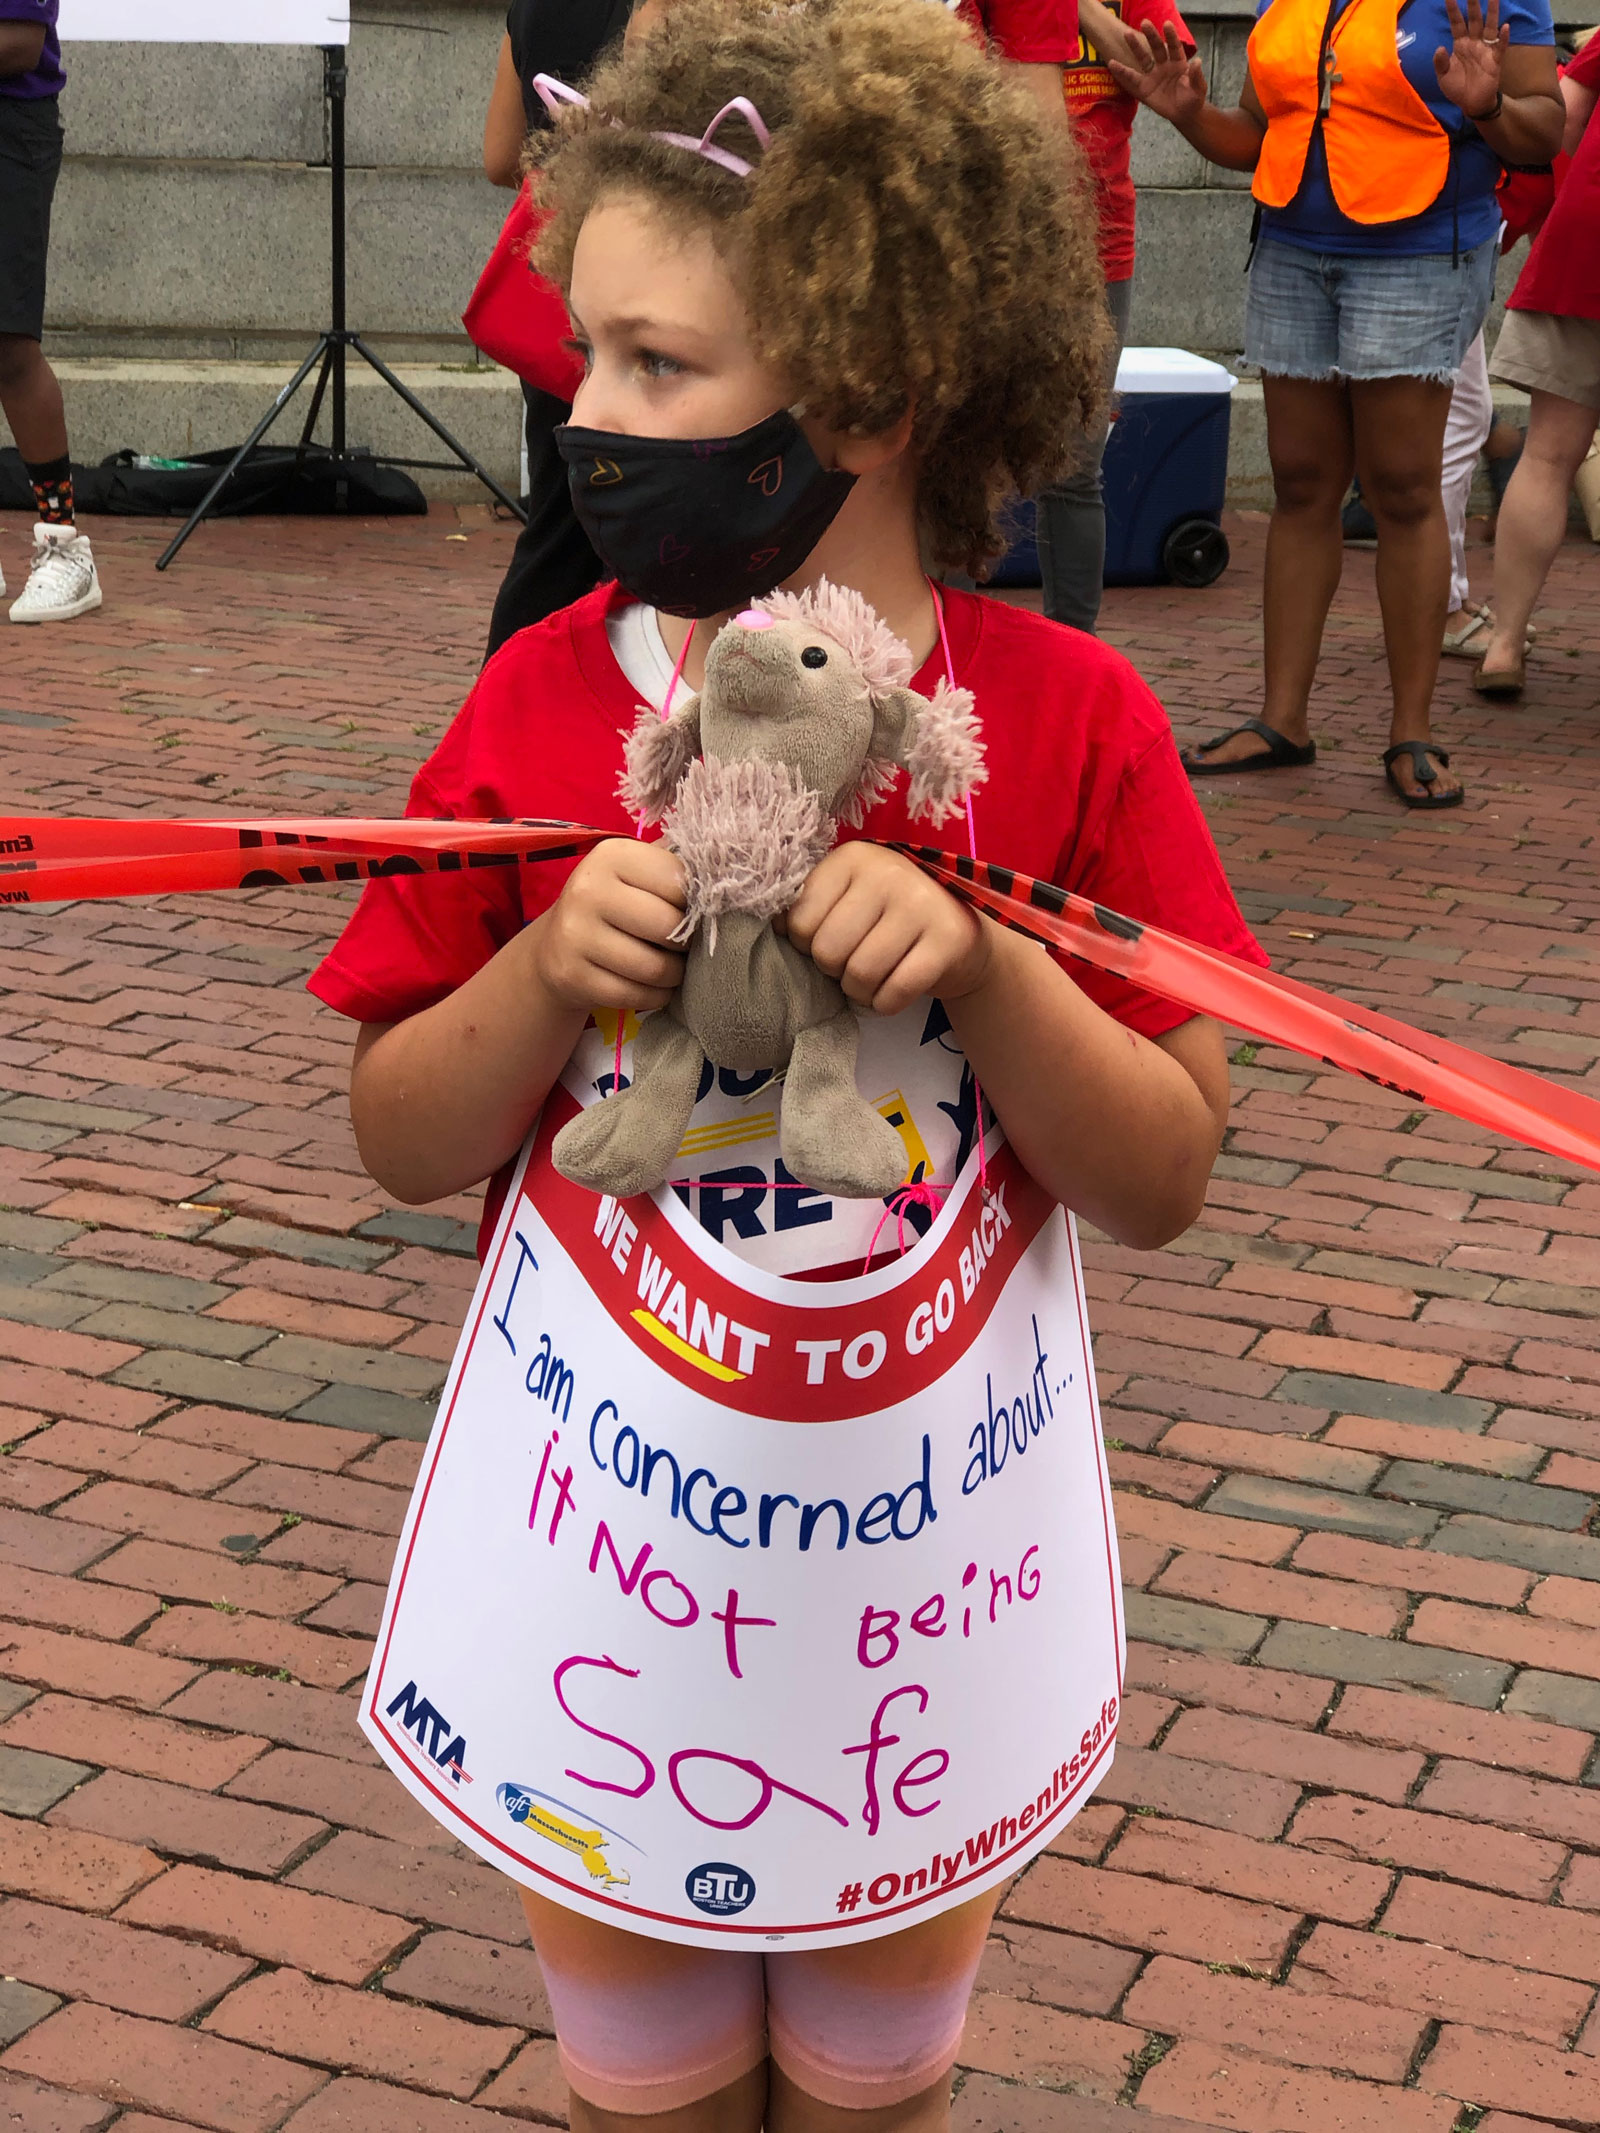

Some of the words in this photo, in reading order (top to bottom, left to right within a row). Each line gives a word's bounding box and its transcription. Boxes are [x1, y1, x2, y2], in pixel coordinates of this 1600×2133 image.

[494, 1231, 539, 1356] I
[526, 1333, 574, 1423] am
[593, 1194, 639, 1276] WE
[637, 1242, 771, 1376] WANT
[795, 1330, 888, 1385] TO
[905, 1278, 955, 1356] GO
[958, 1179, 1012, 1305] BACK
[386, 1680, 467, 1784] MTA
[836, 1697, 1117, 1913] #OnlyWhenItsSafe
[693, 1871, 749, 1903] BTU
